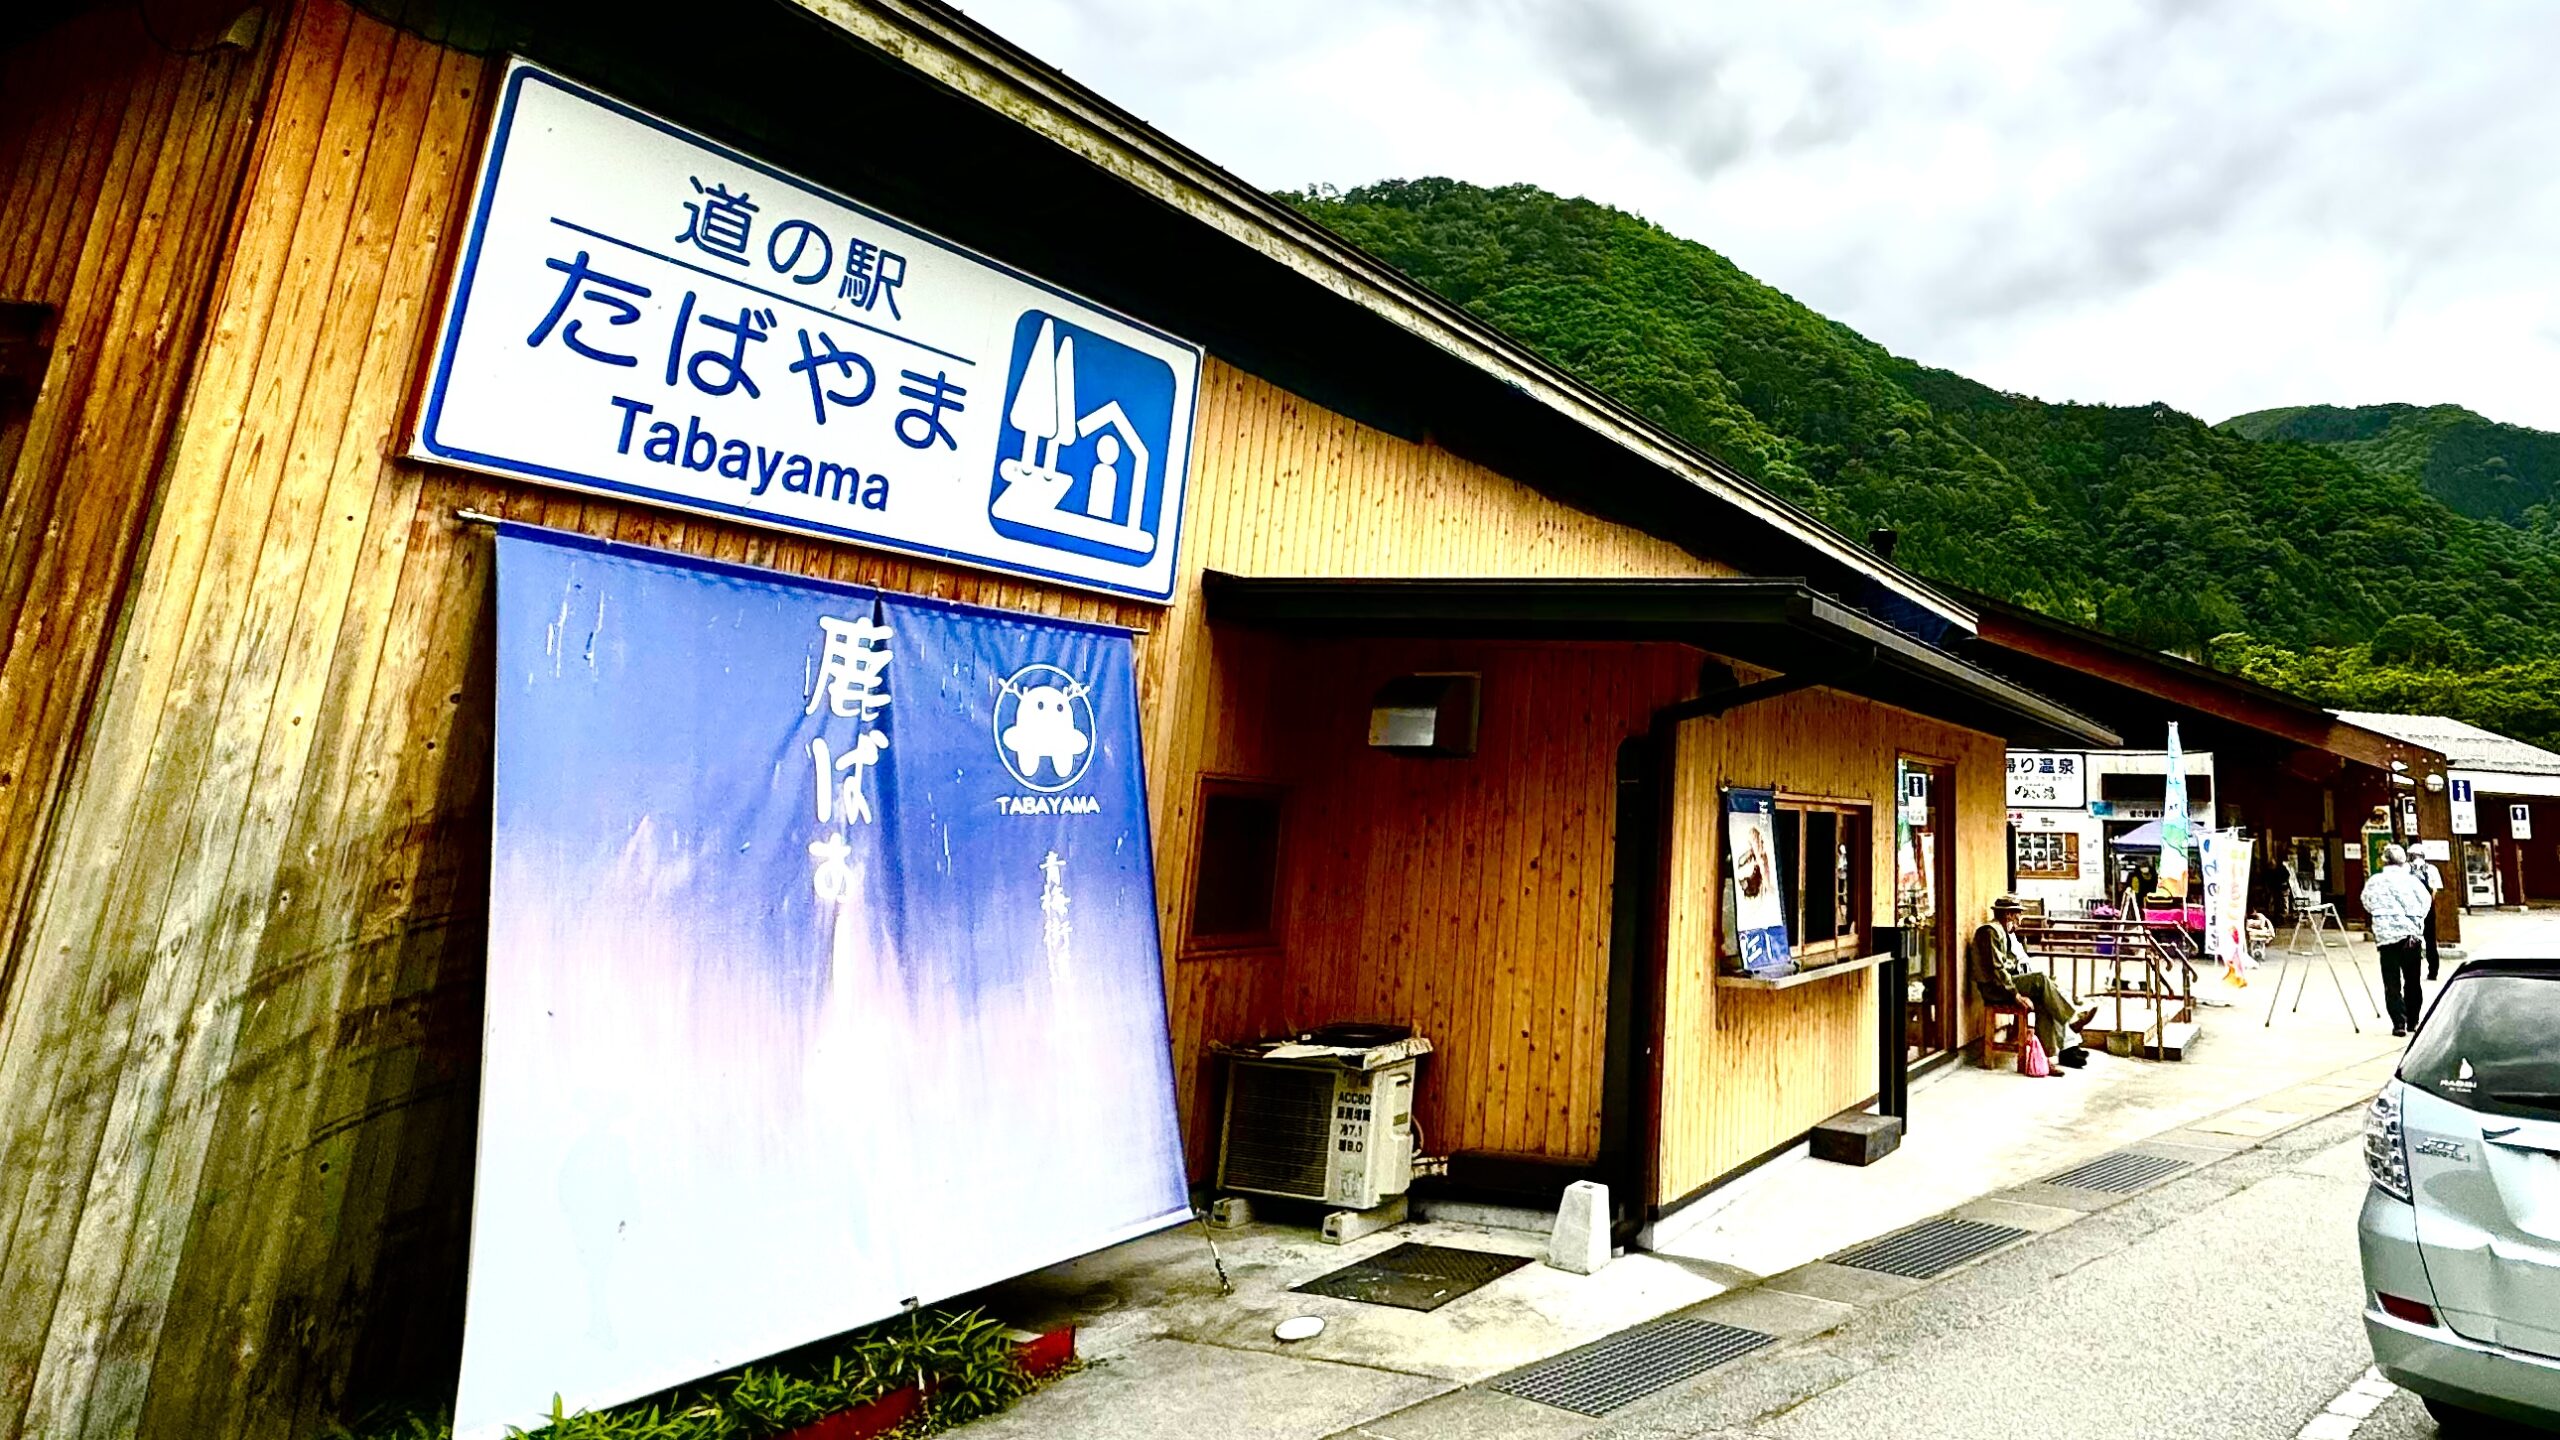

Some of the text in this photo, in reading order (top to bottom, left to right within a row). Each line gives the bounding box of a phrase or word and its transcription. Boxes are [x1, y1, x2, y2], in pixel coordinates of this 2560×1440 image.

[676, 176, 905, 320] 道の駅
[528, 251, 967, 450] たばやま
[611, 397, 889, 511] Tabayama
[996, 796, 1101, 816] TABAYAMA
